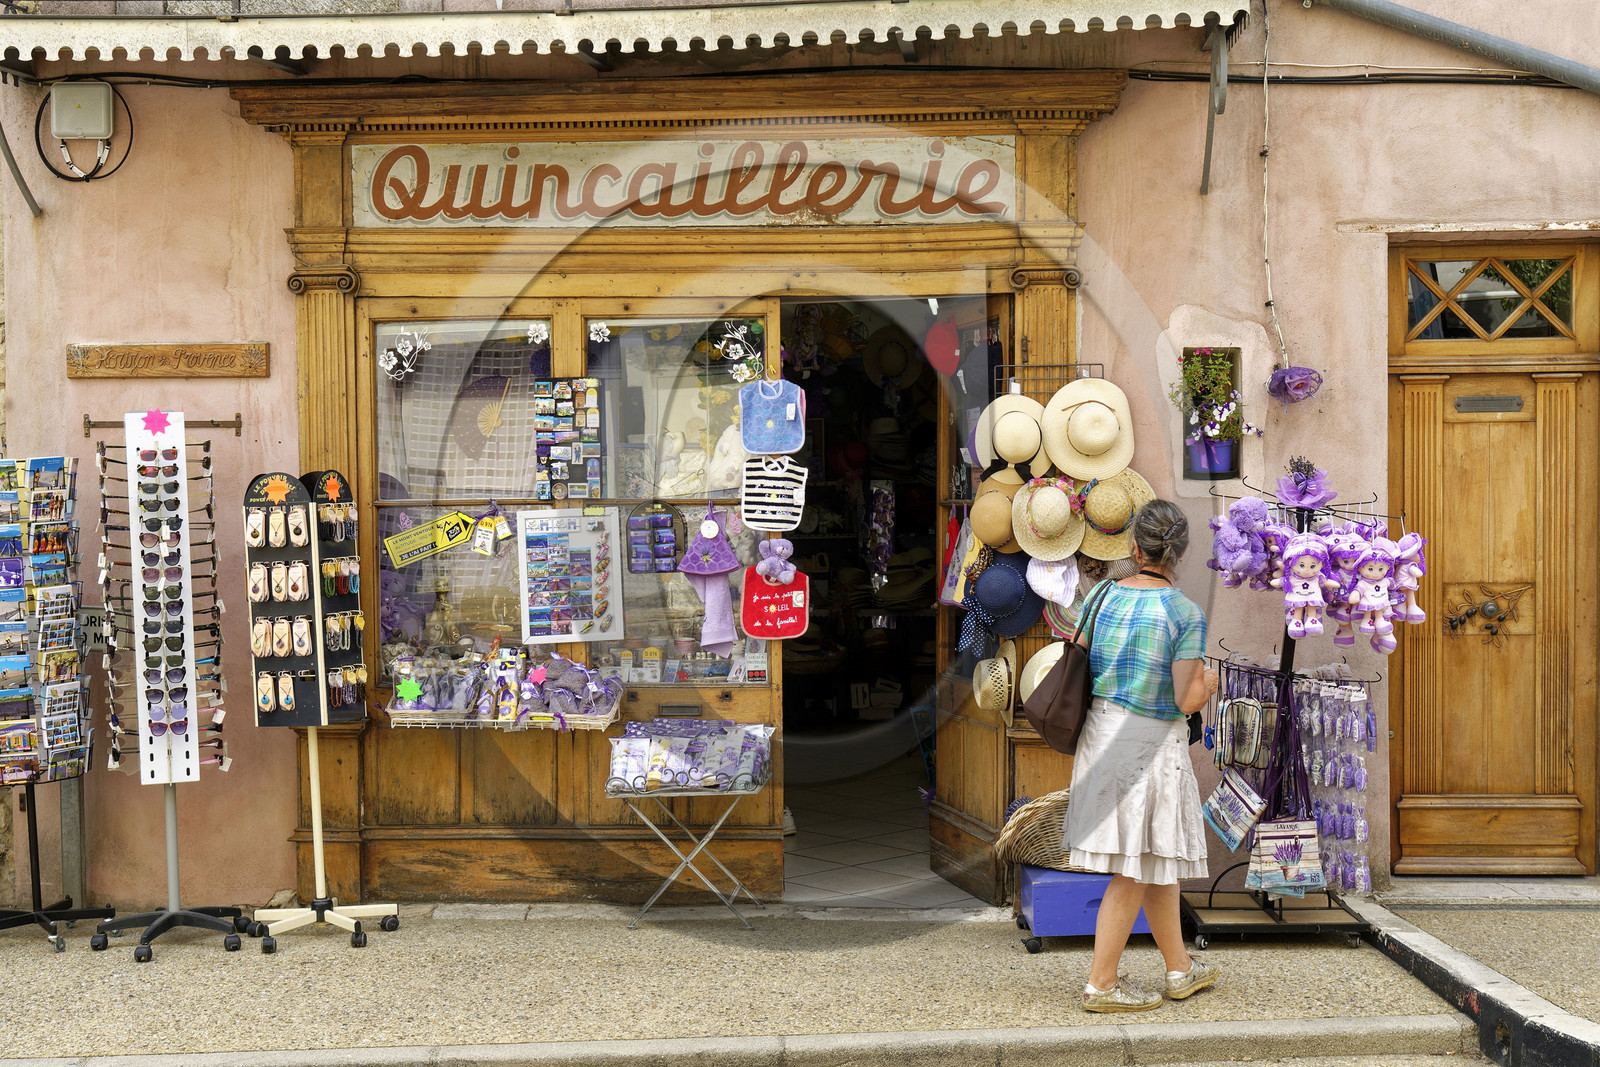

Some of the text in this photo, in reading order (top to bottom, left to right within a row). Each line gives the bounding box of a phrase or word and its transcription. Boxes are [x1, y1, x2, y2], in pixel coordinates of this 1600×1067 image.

[370, 139, 1007, 220] Quincaillerie
[172, 347, 237, 370] Provence
[399, 533, 413, 544] MONT
[413, 525, 435, 537] VENTOUX
[409, 548, 420, 558] L'AI
[419, 544, 433, 554] FAIT
[753, 592, 760, 603] je
